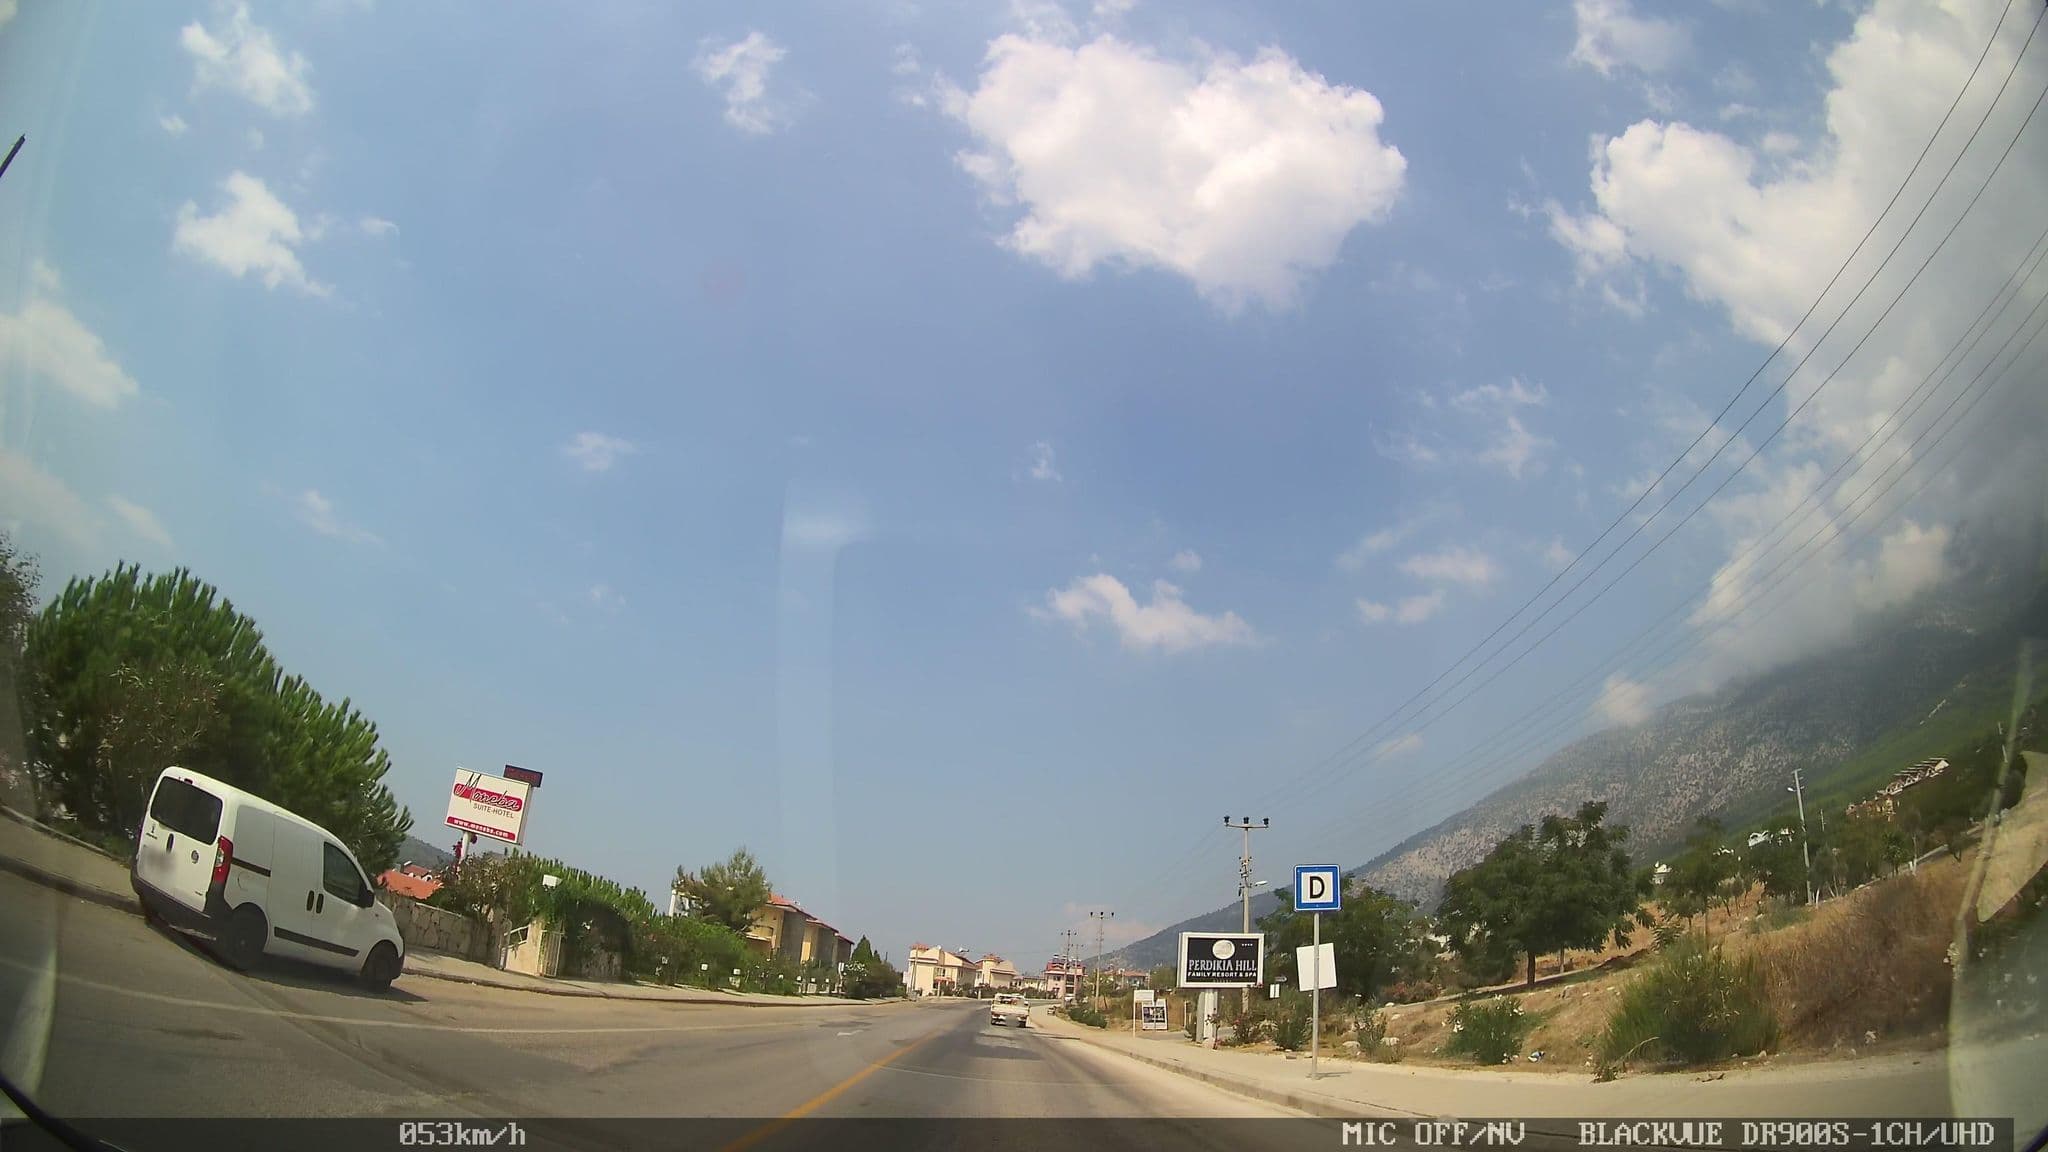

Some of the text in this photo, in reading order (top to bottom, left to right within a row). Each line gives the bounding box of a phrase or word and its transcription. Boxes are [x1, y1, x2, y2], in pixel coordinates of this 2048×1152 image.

[1309, 875, 1326, 899] D
[1188, 959, 1257, 971] PERDIKIA HILL
